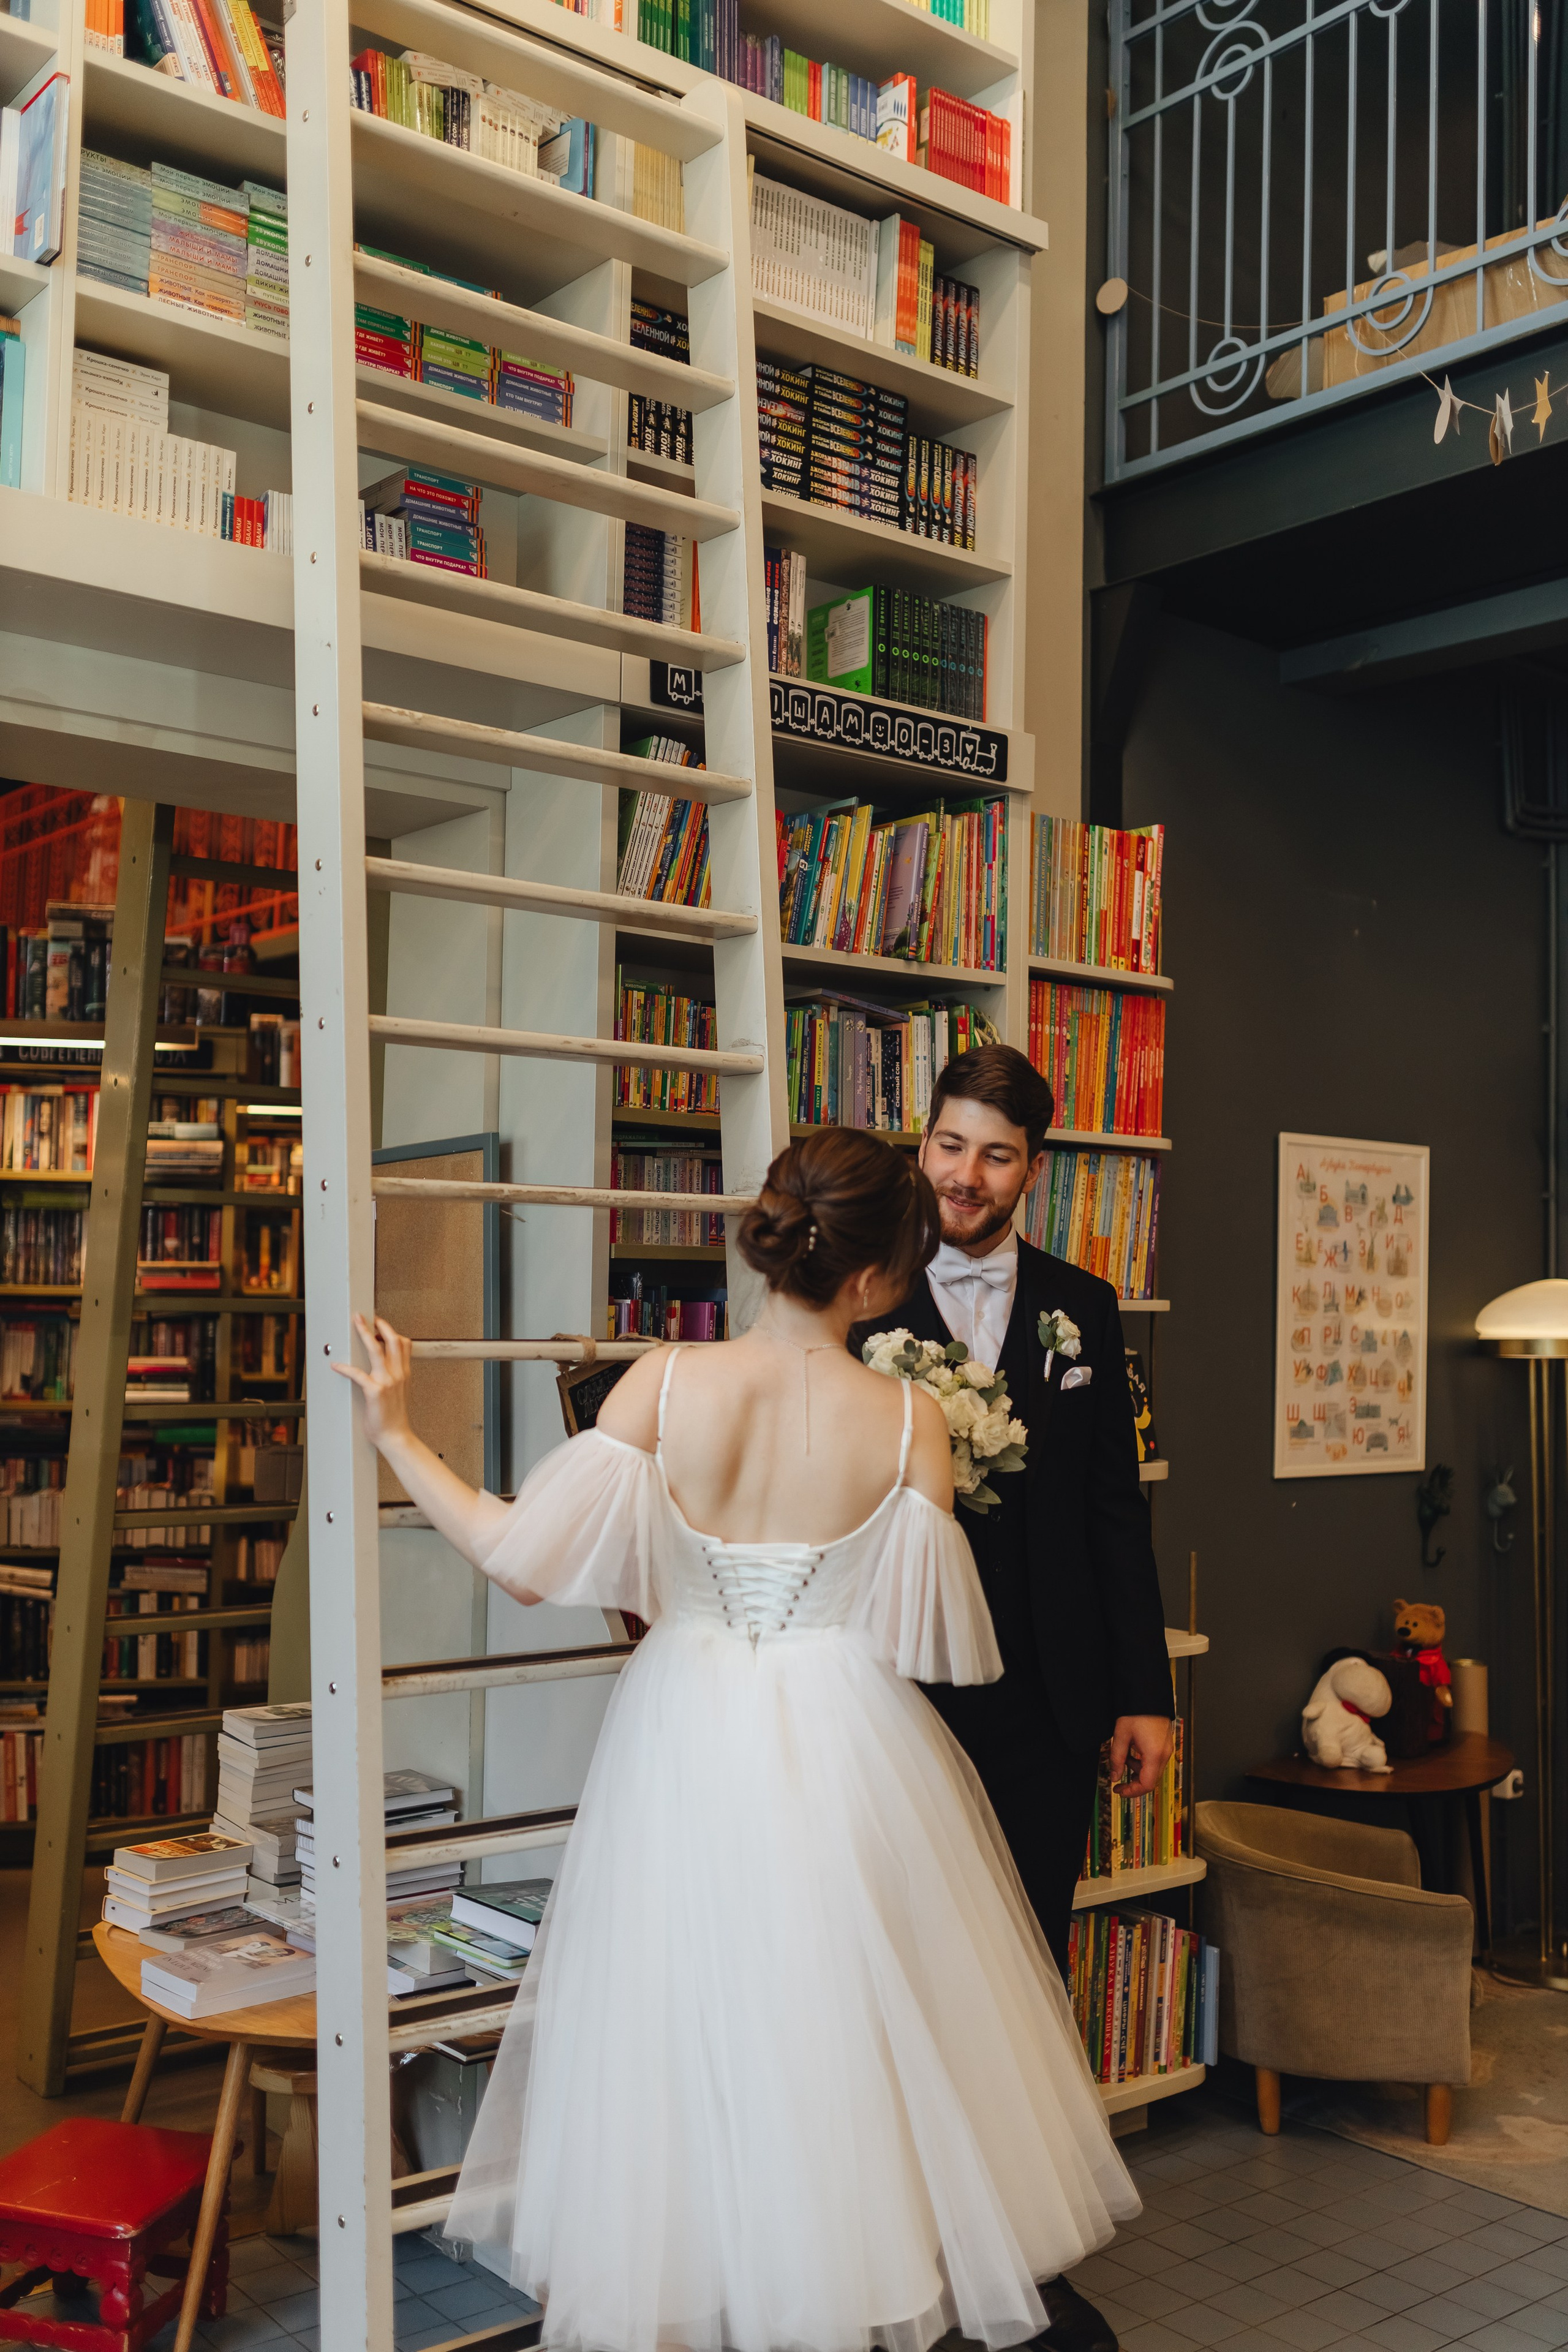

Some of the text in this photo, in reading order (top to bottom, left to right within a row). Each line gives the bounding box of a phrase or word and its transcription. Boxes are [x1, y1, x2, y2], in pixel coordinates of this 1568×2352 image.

[176, 173, 200, 184] первые
[202, 181, 230, 194] ЭМОЦИИ
[176, 184, 200, 195] первые
[202, 192, 230, 204] ЭМОЦИИ
[180, 197, 213, 212] ЭМОЦИИ
[181, 208, 213, 222] ЭМОЦИИ
[169, 236, 203, 252] МАЛЫШИ
[215, 252, 237, 263] МАМЫ
[157, 254, 197, 271] ТРАНСПОРТ
[170, 246, 204, 262] МАЛЫШИ
[216, 261, 238, 273] МАМЫ
[157, 266, 197, 282] ТРАНСПОРТ
[159, 277, 194, 293] ЖИВОТНЫЕ.
[207, 294, 234, 306] «говорят»
[255, 279, 276, 290] ДИКИЕ
[158, 288, 192, 303] ЖИВОТНЫЕ.
[206, 303, 233, 315] «говорят»
[158, 297, 224, 322] ЛЕСНЫЕ ЖИВОТНЫЕ
[253, 312, 285, 326] ЖИВОТНЫЕ
[369, 307, 396, 320] СПРЯТАЛСЯ?
[254, 324, 286, 339] ЖИВОТНЫЕ
[368, 320, 396, 333] СПРЯТАЛСЯ?
[366, 334, 384, 344] ЖИВЁТ?
[446, 333, 470, 344] ЖИВОТНЫЕ
[368, 347, 386, 357] ЖИВЁТ?
[86, 356, 129, 372] Крошка-семечко
[358, 359, 400, 375] ВНУТРИ ПОДАРКА?
[80, 369, 123, 385] Крошка-семечко
[428, 366, 477, 384] ДОМАШНИЕ ЖИВОТНЫЕ
[517, 368, 533, 377] ВНУТРИ
[533, 374, 556, 384] ПОДАРКА?
[781, 370, 810, 388] ХОКИНГ
[429, 380, 454, 391] ТРАНСПОРТ
[505, 379, 552, 397] ДОМАШНИЕ ЖИВОТНЫЕ
[85, 386, 127, 402] Крошка-семечко
[524, 397, 543, 407] ВНУТРИ?
[781, 386, 809, 405] ХОКИНГ
[777, 420, 807, 437] ХОКИНГ
[777, 435, 805, 454] ХОКИНГ
[770, 453, 802, 470] ХОКИНГ
[414, 473, 439, 483] ТРАНСПОРТ
[405, 498, 456, 514] ДОМАШНИЕ ЖИВОТНЫЕ
[436, 493, 456, 503] ПОХОЖЕ?
[417, 527, 442, 538] ТРАНСПОРТ
[426, 556, 443, 565] ВНУТРИ
[444, 561, 466, 570] ПОДАРКА?
[808, 890, 816, 920] НАСЕКОМЫЕ
[1153, 1213, 1157, 1223] НА
